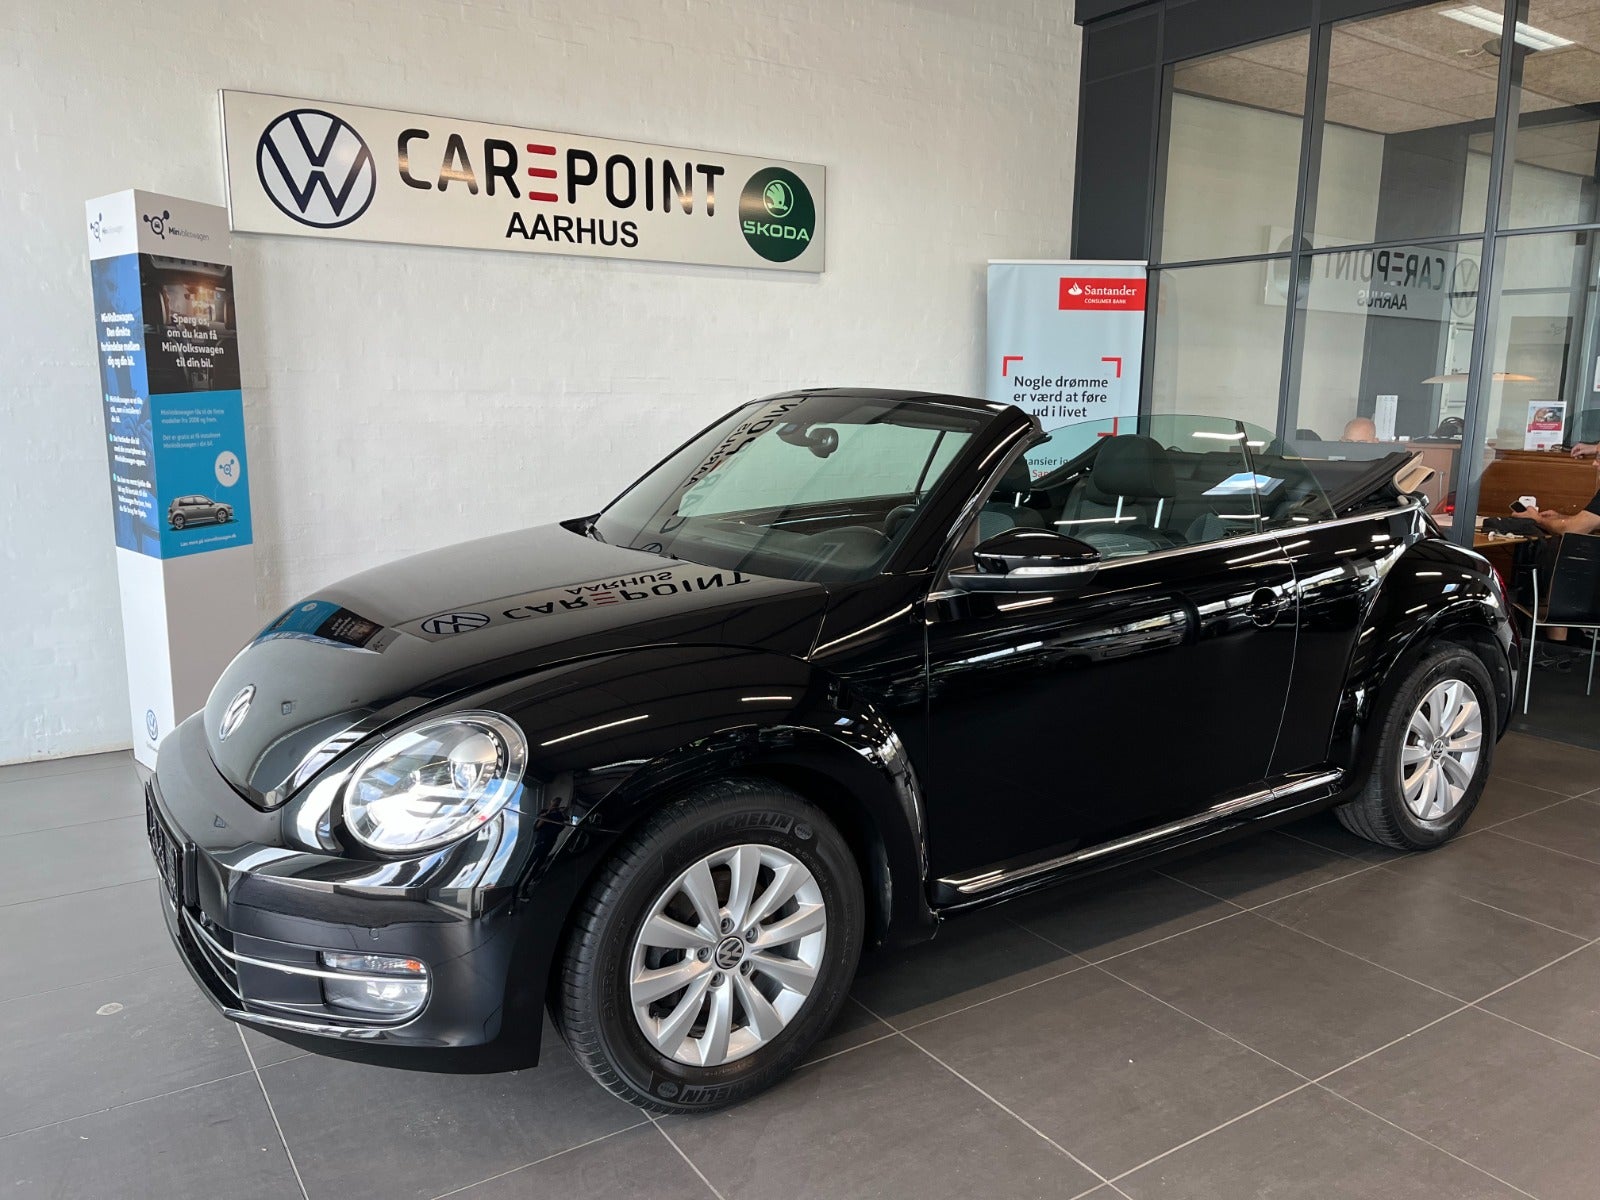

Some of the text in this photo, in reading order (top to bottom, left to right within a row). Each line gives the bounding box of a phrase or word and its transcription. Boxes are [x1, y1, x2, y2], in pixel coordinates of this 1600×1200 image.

[397, 128, 725, 217] CAREPOINT
[506, 211, 639, 248] AARHUS
[1084, 284, 1137, 297] Santander
[172, 313, 198, 327] Spørg
[167, 329, 217, 340] om du kan få
[162, 342, 224, 356] MinVolkswagen
[176, 358, 213, 368] til din bil.
[1014, 376, 1108, 390] Nogle drømme
[1013, 391, 1107, 403] er værd at føre
[1032, 406, 1087, 417] ud i livet
[1026, 456, 1058, 466] ansier
